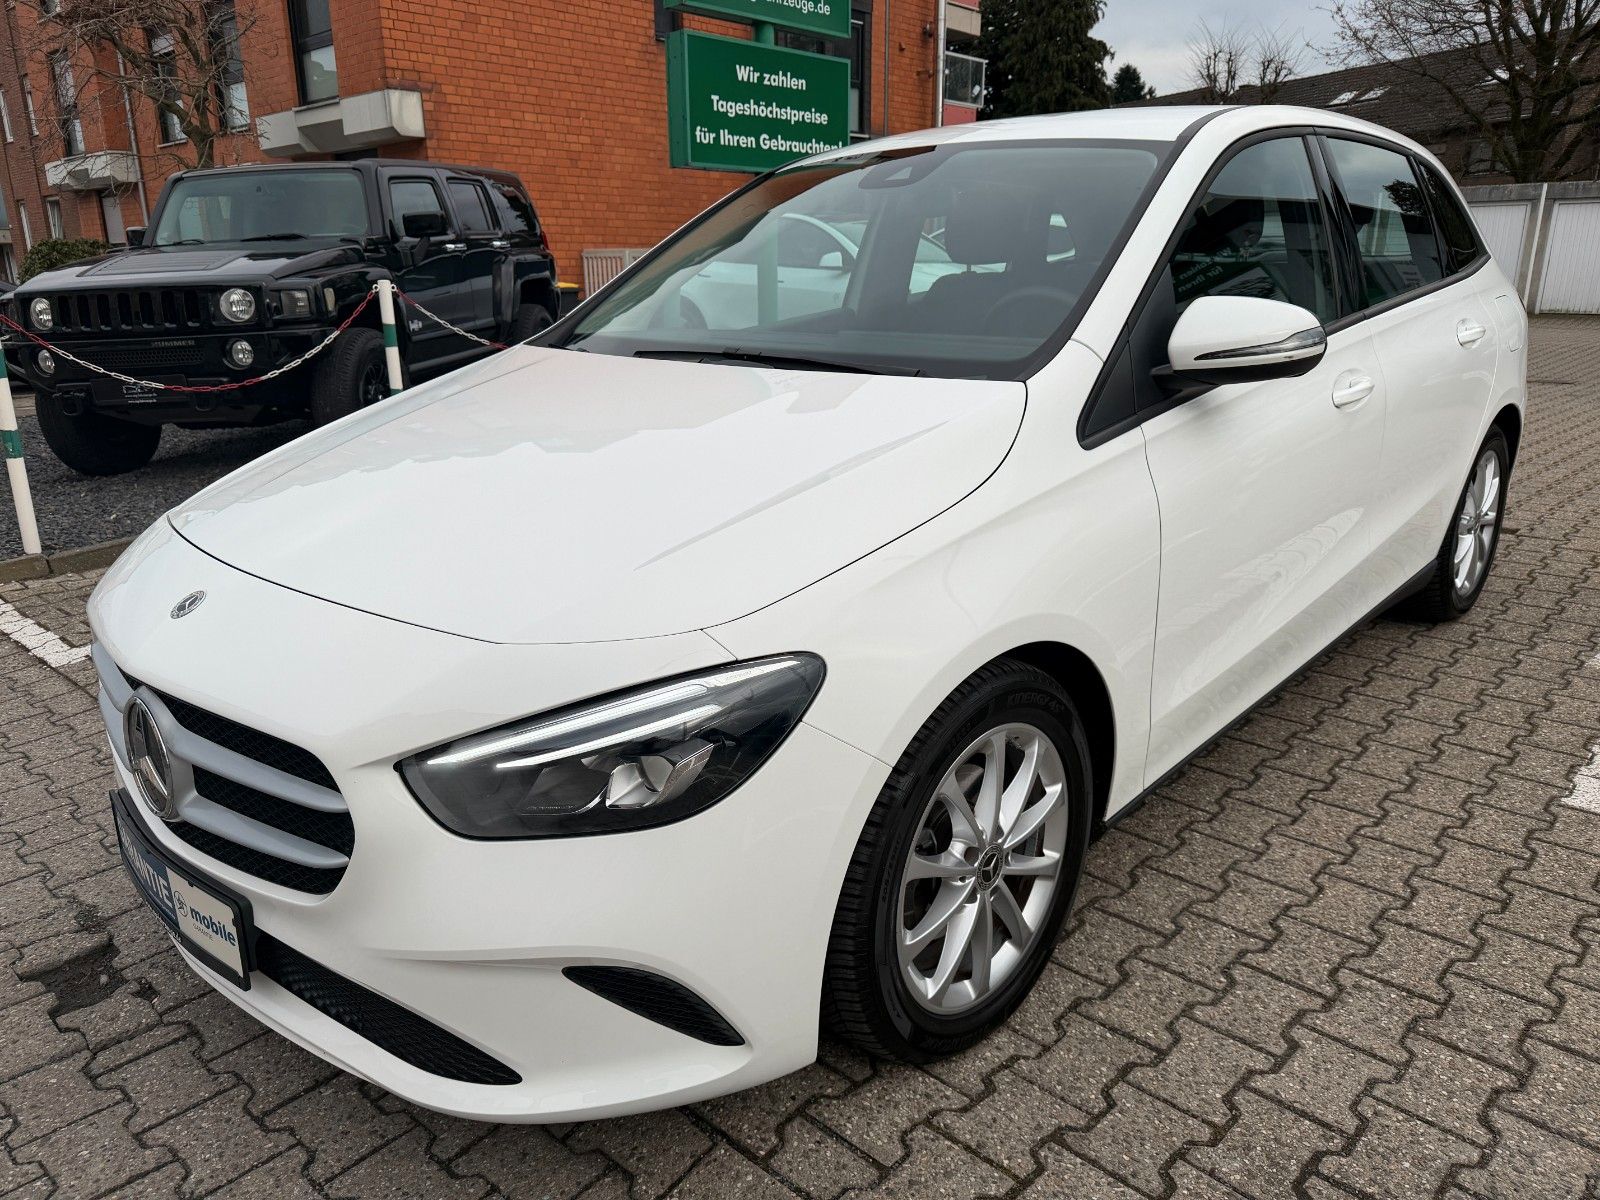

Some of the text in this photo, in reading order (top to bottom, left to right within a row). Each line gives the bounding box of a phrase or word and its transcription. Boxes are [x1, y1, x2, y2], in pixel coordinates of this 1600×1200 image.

[736, 64, 807, 90] Wir zahlen
[711, 95, 828, 125] Tageshöchstpreise
[695, 126, 716, 144] für
[720, 129, 756, 148] Ihren
[189, 905, 236, 947] mobile
